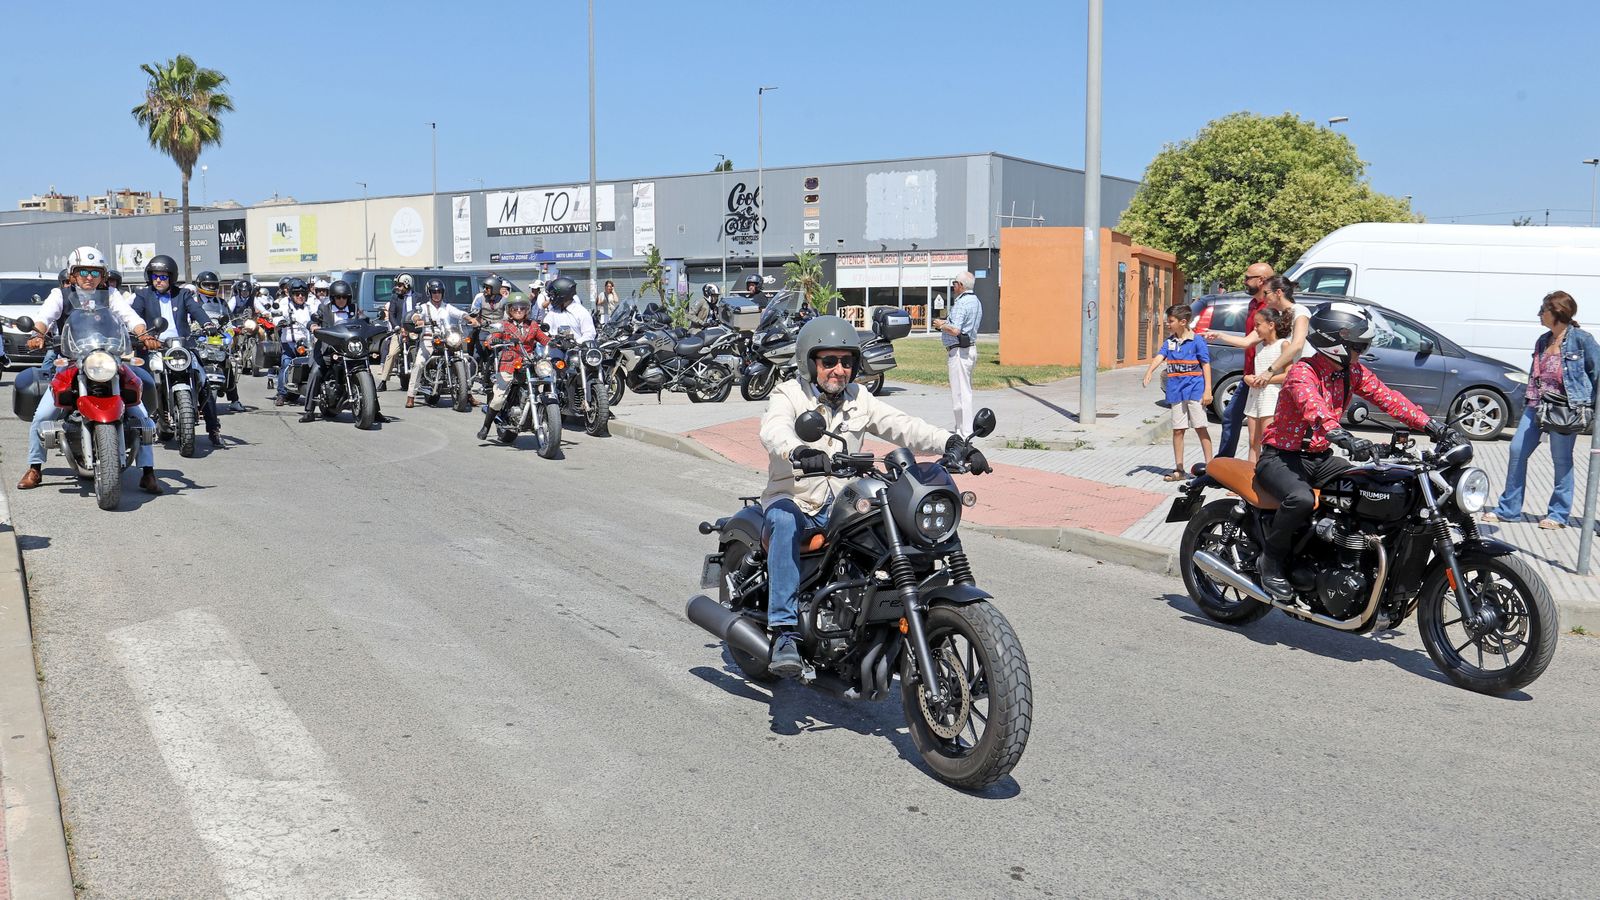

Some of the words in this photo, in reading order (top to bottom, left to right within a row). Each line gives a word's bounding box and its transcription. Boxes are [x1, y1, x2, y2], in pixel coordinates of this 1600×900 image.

[499, 228, 523, 236] TALLER
[525, 225, 564, 235] MECANICO
[566, 224, 572, 232] Y
[573, 222, 603, 232] VENS
[220, 233, 237, 243] YAK
[1359, 489, 1390, 501] TRIUMPH
